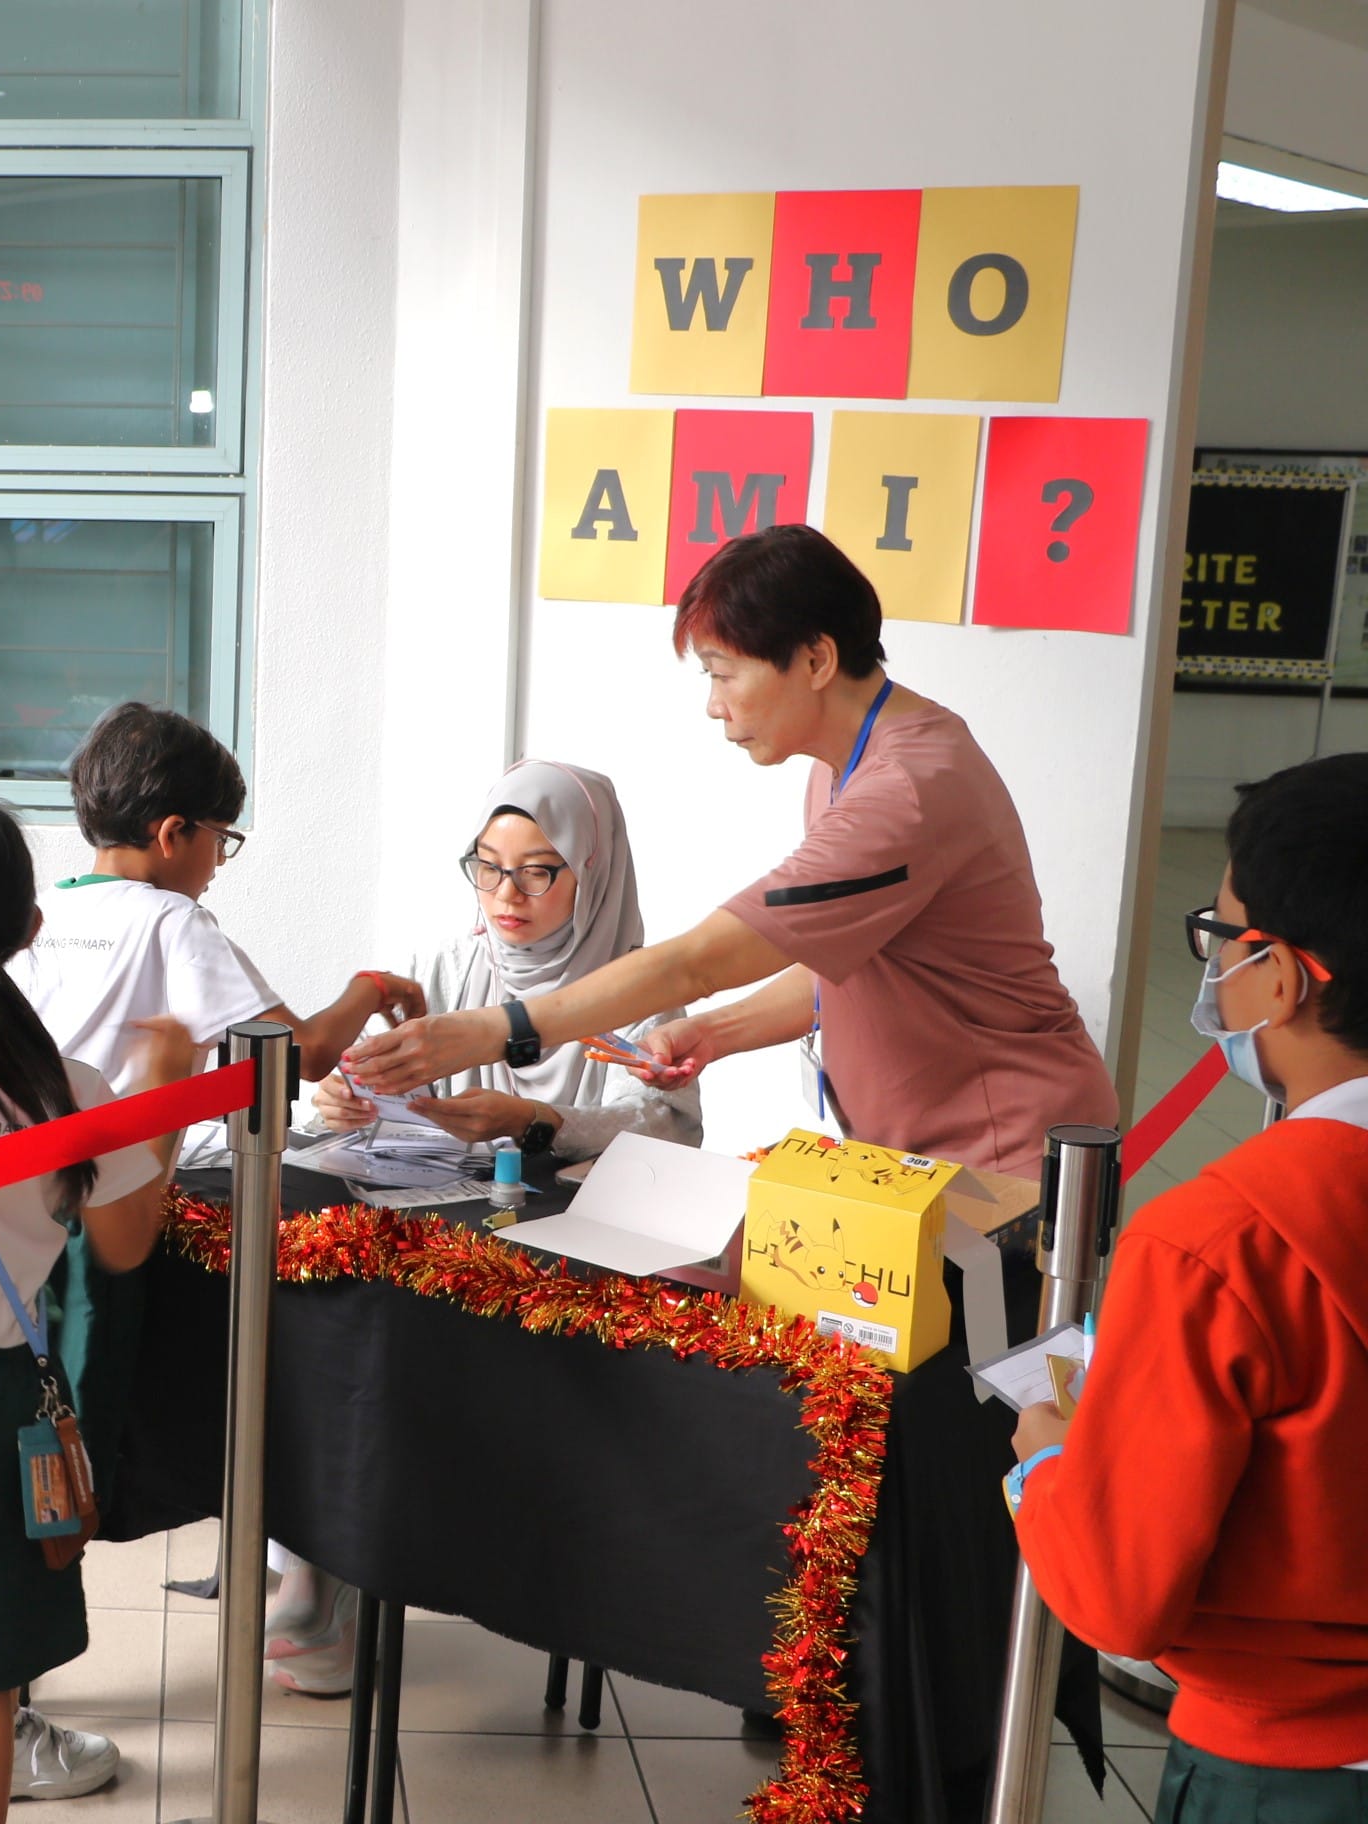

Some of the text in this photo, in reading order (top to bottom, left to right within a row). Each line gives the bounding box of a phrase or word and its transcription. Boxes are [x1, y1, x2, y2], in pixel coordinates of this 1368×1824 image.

[654, 252, 1030, 337] WHO
[570, 469, 786, 545] AM
[69, 938, 115, 951] PRIMARY
